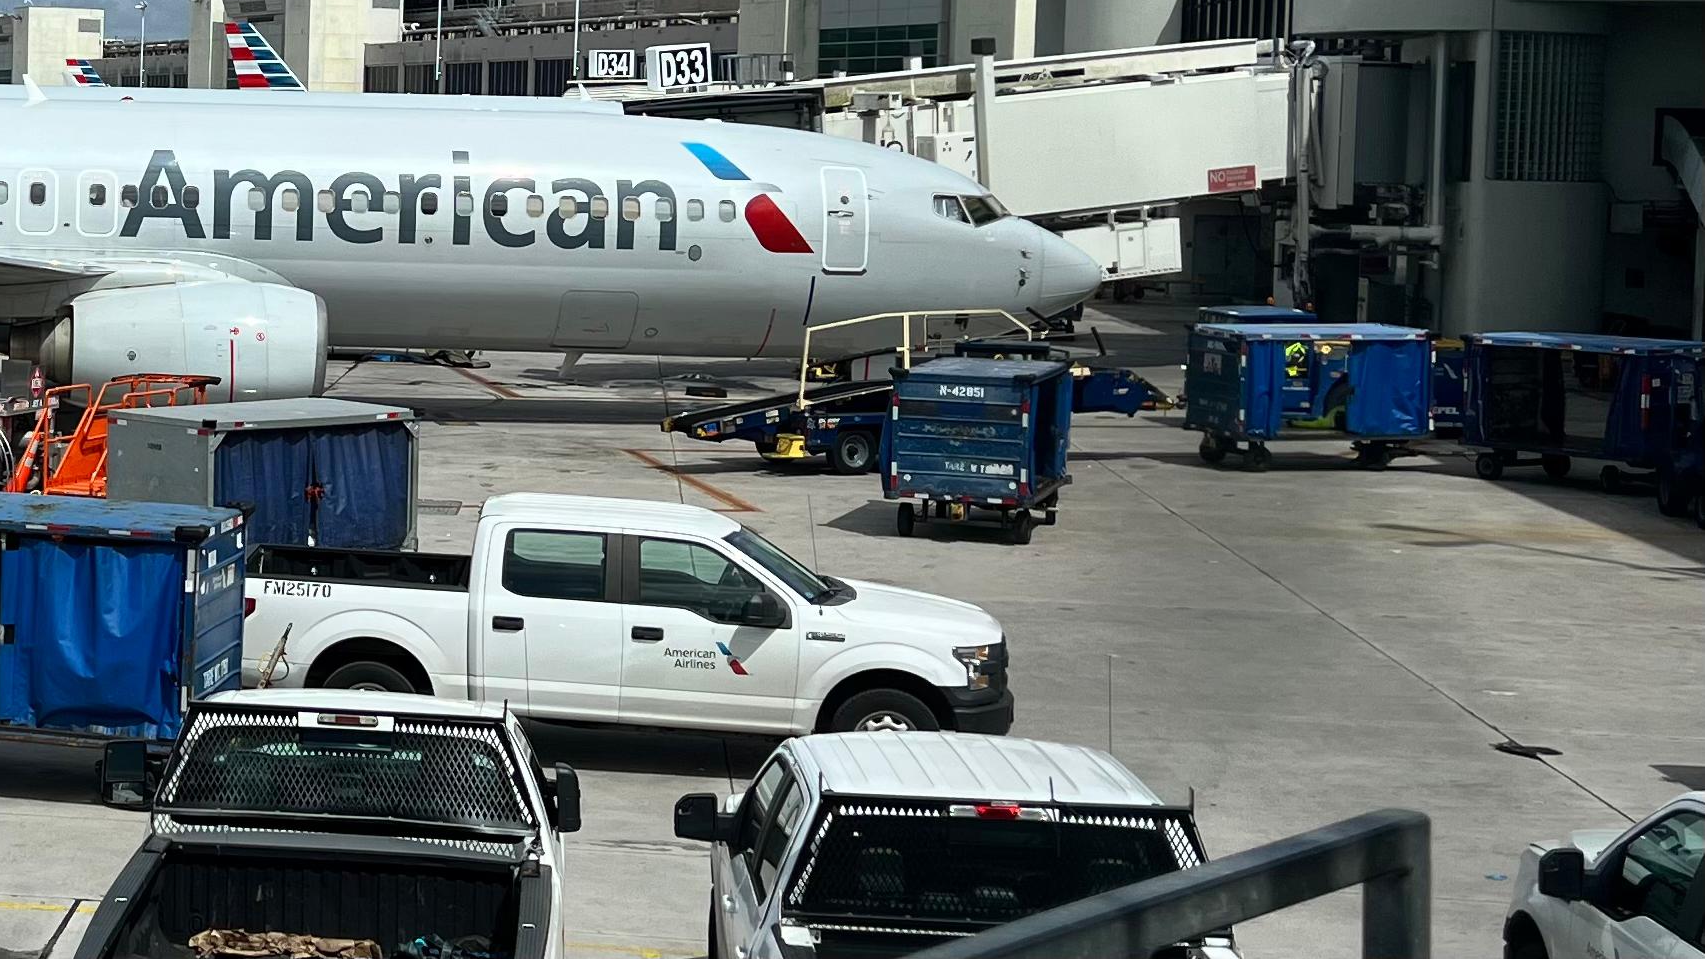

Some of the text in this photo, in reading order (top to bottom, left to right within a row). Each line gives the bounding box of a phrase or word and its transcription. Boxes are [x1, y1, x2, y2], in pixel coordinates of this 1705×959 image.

[598, 52, 629, 76] D34
[660, 49, 705, 87] D33
[1209, 170, 1226, 184] NO
[119, 149, 678, 251] American
[264, 580, 332, 598] FM25170
[664, 647, 717, 659] American
[674, 658, 716, 670] Airlines
